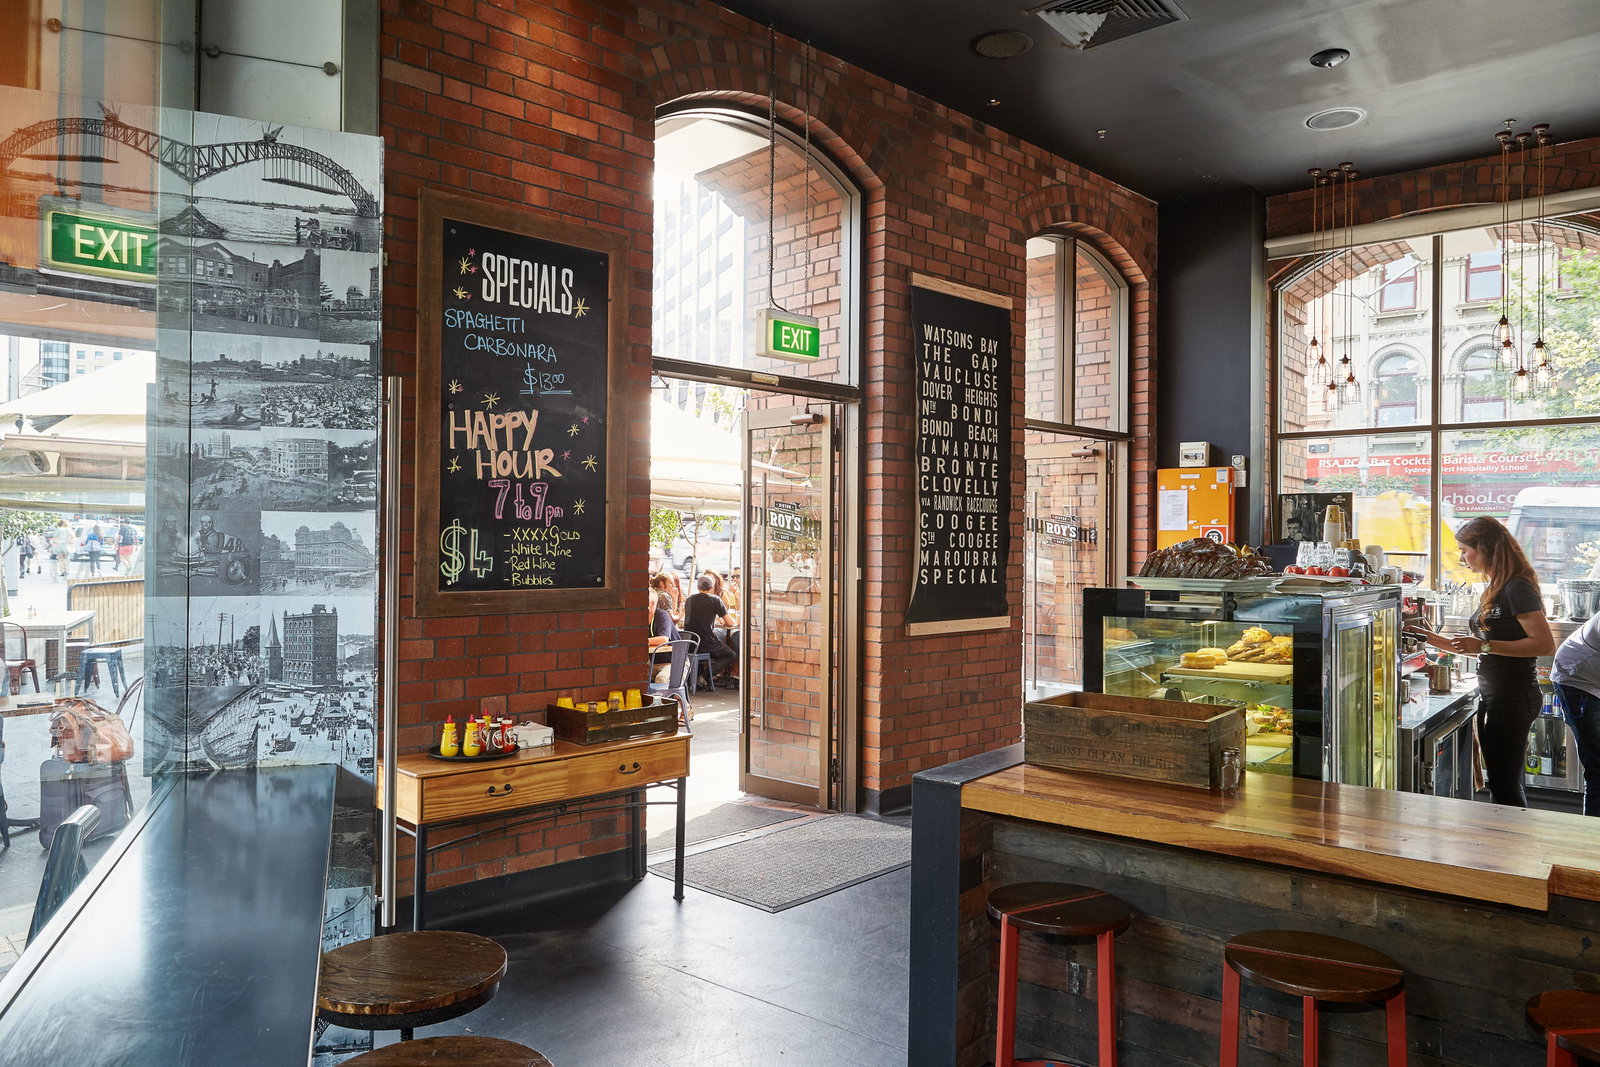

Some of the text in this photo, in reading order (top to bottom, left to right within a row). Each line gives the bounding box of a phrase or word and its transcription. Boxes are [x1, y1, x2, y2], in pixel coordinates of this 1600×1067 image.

[75, 223, 148, 266] EXIT
[482, 252, 574, 316] SPECIALS
[444, 308, 525, 334] SPAGHETTI
[464, 333, 557, 363] CARBONARA
[781, 325, 812, 352] EXIT
[923, 324, 998, 356] WATSONS BAY
[923, 343, 998, 372] THE GAP
[923, 362, 998, 391] VAUCLUSE
[922, 380, 998, 408] DOVER HEIGHTS
[951, 404, 998, 426] BONDI
[449, 409, 539, 451] HAPPY
[922, 418, 998, 443] BONDI BEACH
[922, 437, 998, 461] TAMARAMA
[1318, 459, 1339, 468] RSA
[1394, 456, 1432, 466] Cockta
[1443, 455, 1485, 464] Barista
[1489, 453, 1539, 463] Courses
[476, 448, 563, 480] HOUR
[921, 456, 998, 479] BRONTE
[1456, 464, 1499, 472] Hospitality
[921, 475, 998, 496] CLOVELLY
[488, 479, 510, 519] 7
[921, 495, 998, 513] VIA RANDWICK RACECOURSE
[769, 511, 801, 532] ROY'S
[920, 513, 998, 531] COOGEE
[1046, 522, 1077, 538] ROY'S
[440, 518, 494, 584] $4
[546, 543, 572, 557] Wine
[949, 532, 998, 549] COOGEE
[533, 556, 555, 570] Wine
[920, 550, 998, 567] MAROUBRA
[920, 568, 998, 584] SPECIAL
